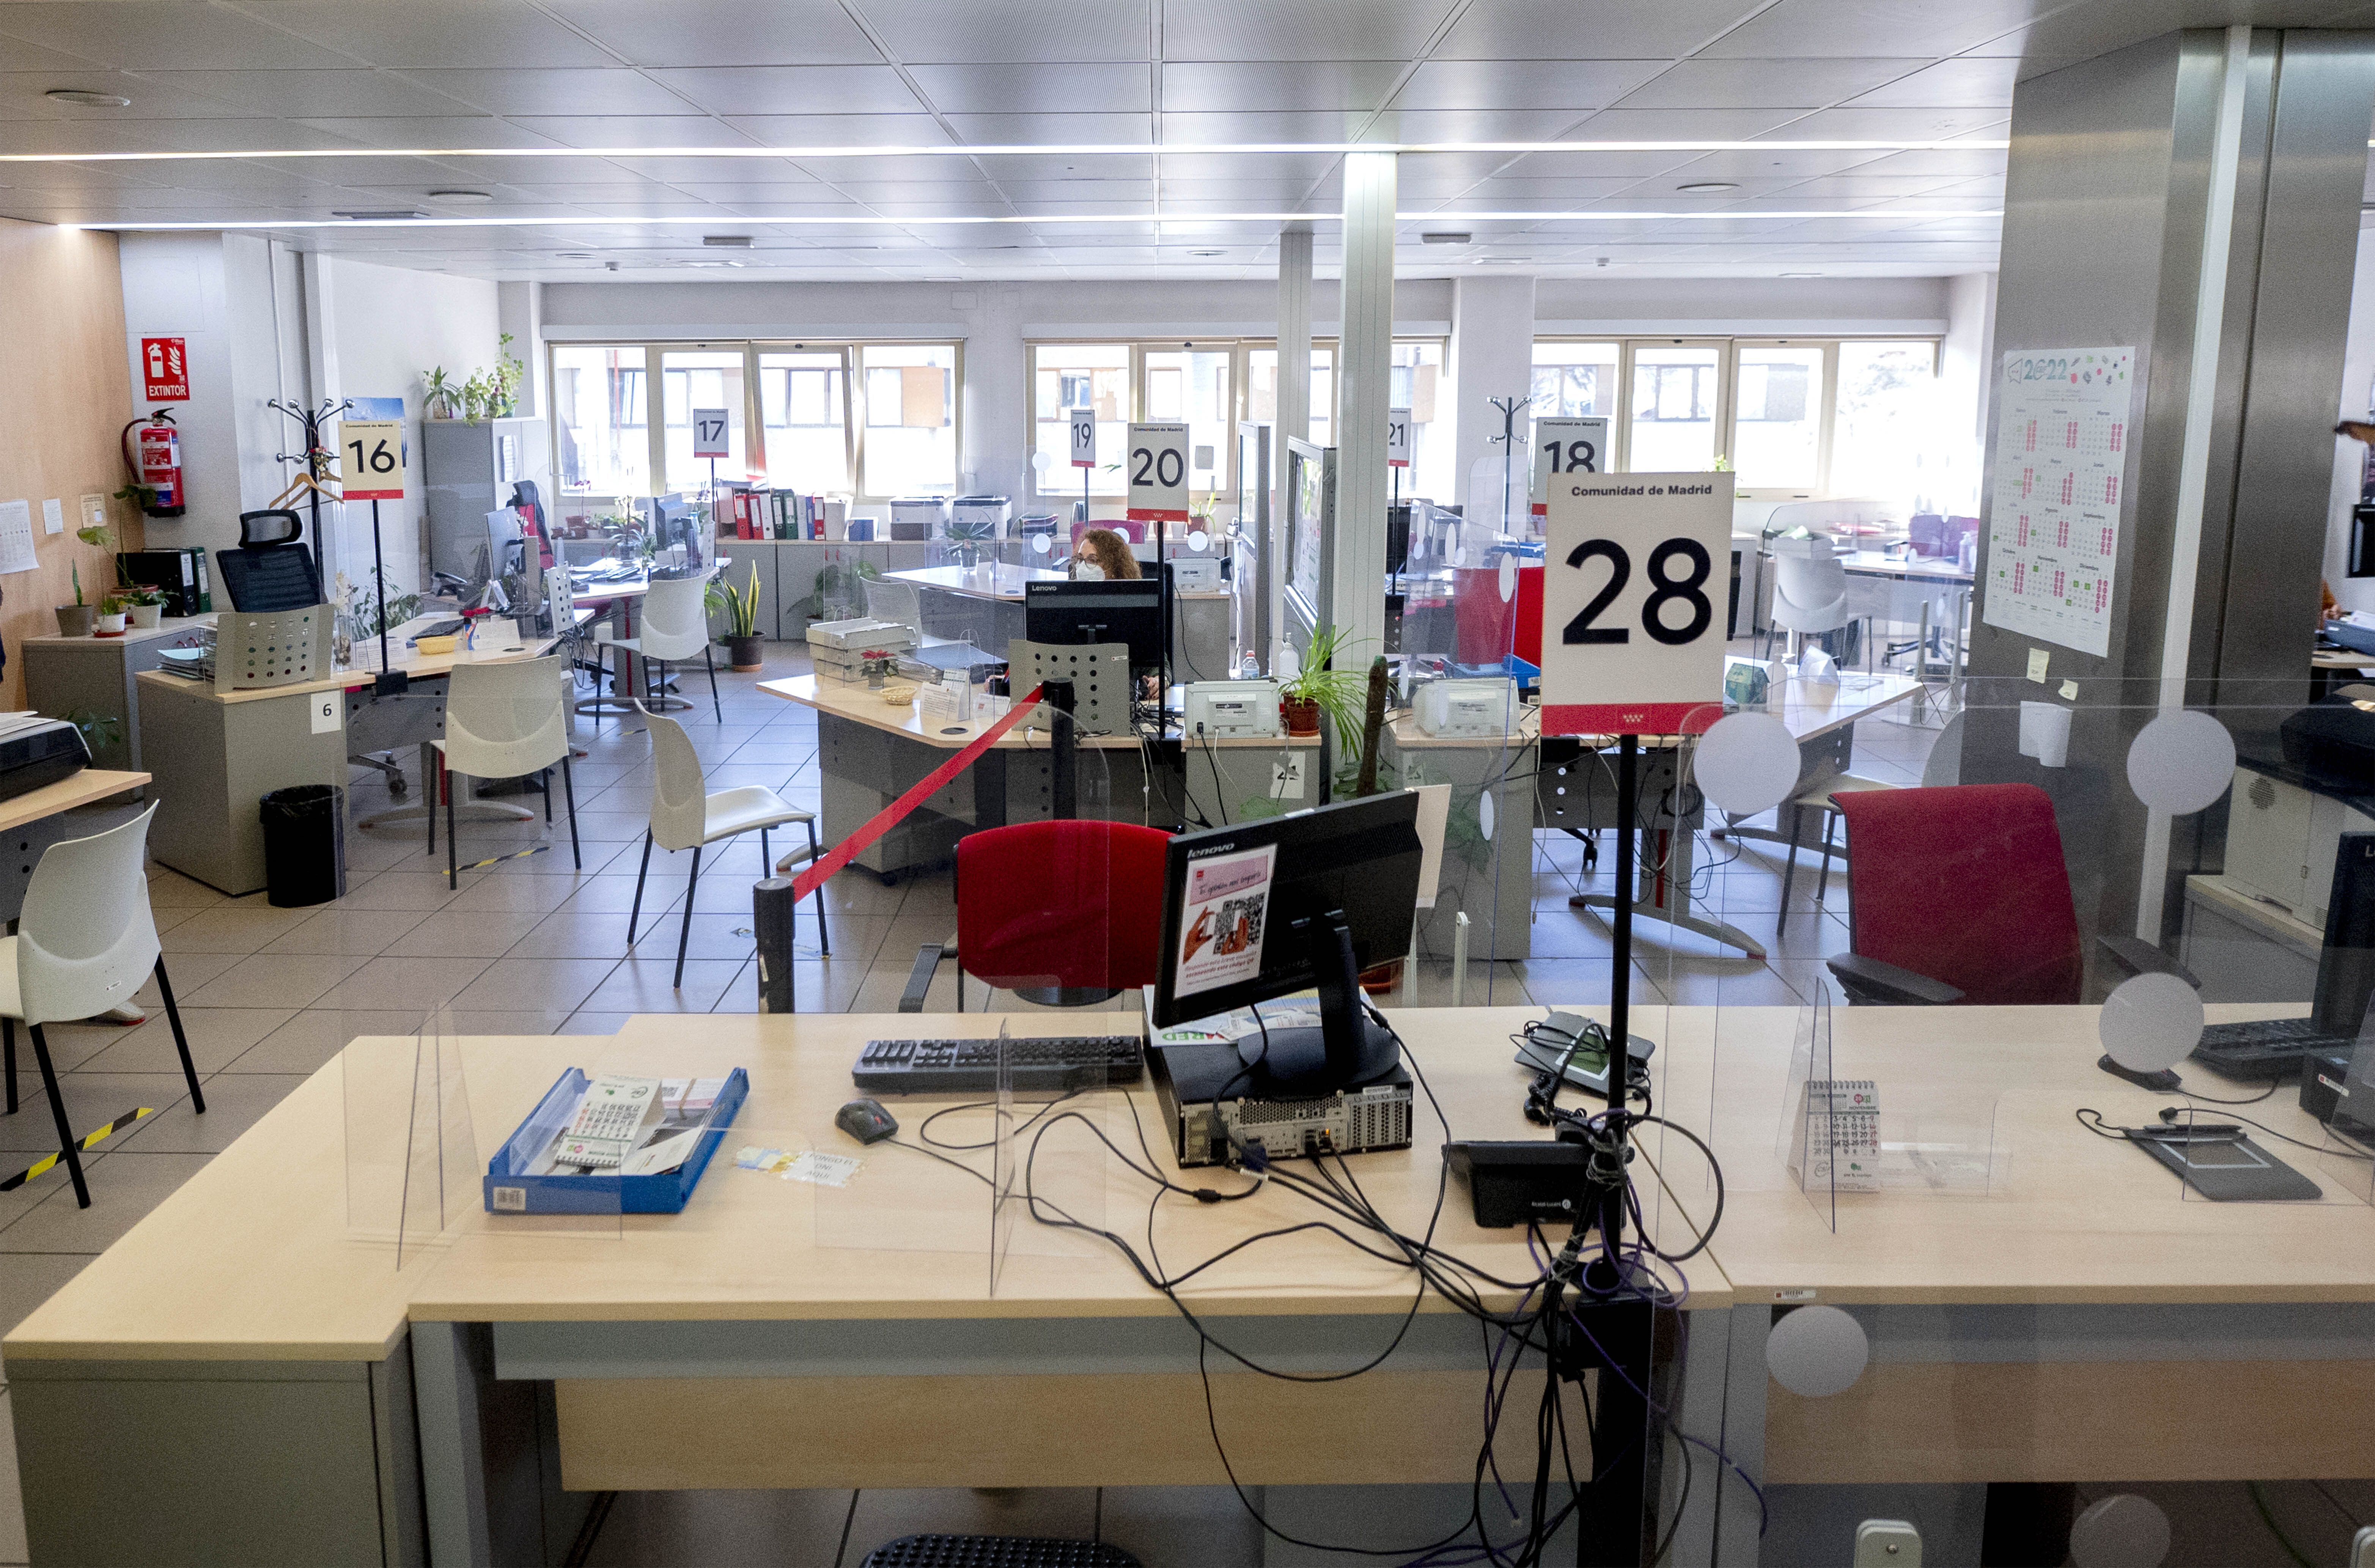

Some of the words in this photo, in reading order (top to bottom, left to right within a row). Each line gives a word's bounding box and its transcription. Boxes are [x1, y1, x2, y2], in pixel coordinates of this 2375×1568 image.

[149, 385, 186, 396] EXTINTOR
[698, 420, 724, 441] 17
[1073, 423, 1091, 448] 19
[1389, 423, 1404, 446] 21
[348, 439, 395, 473] 16
[1132, 448, 1184, 487] 20
[1543, 441, 1595, 473] 18
[1572, 486, 1644, 496] Comunidad
[1648, 485, 1663, 495] de
[1668, 485, 1712, 495] Madrid
[1562, 537, 1712, 645] 28
[323, 704, 332, 716] 6
[1188, 843, 1235, 858] lenovo
